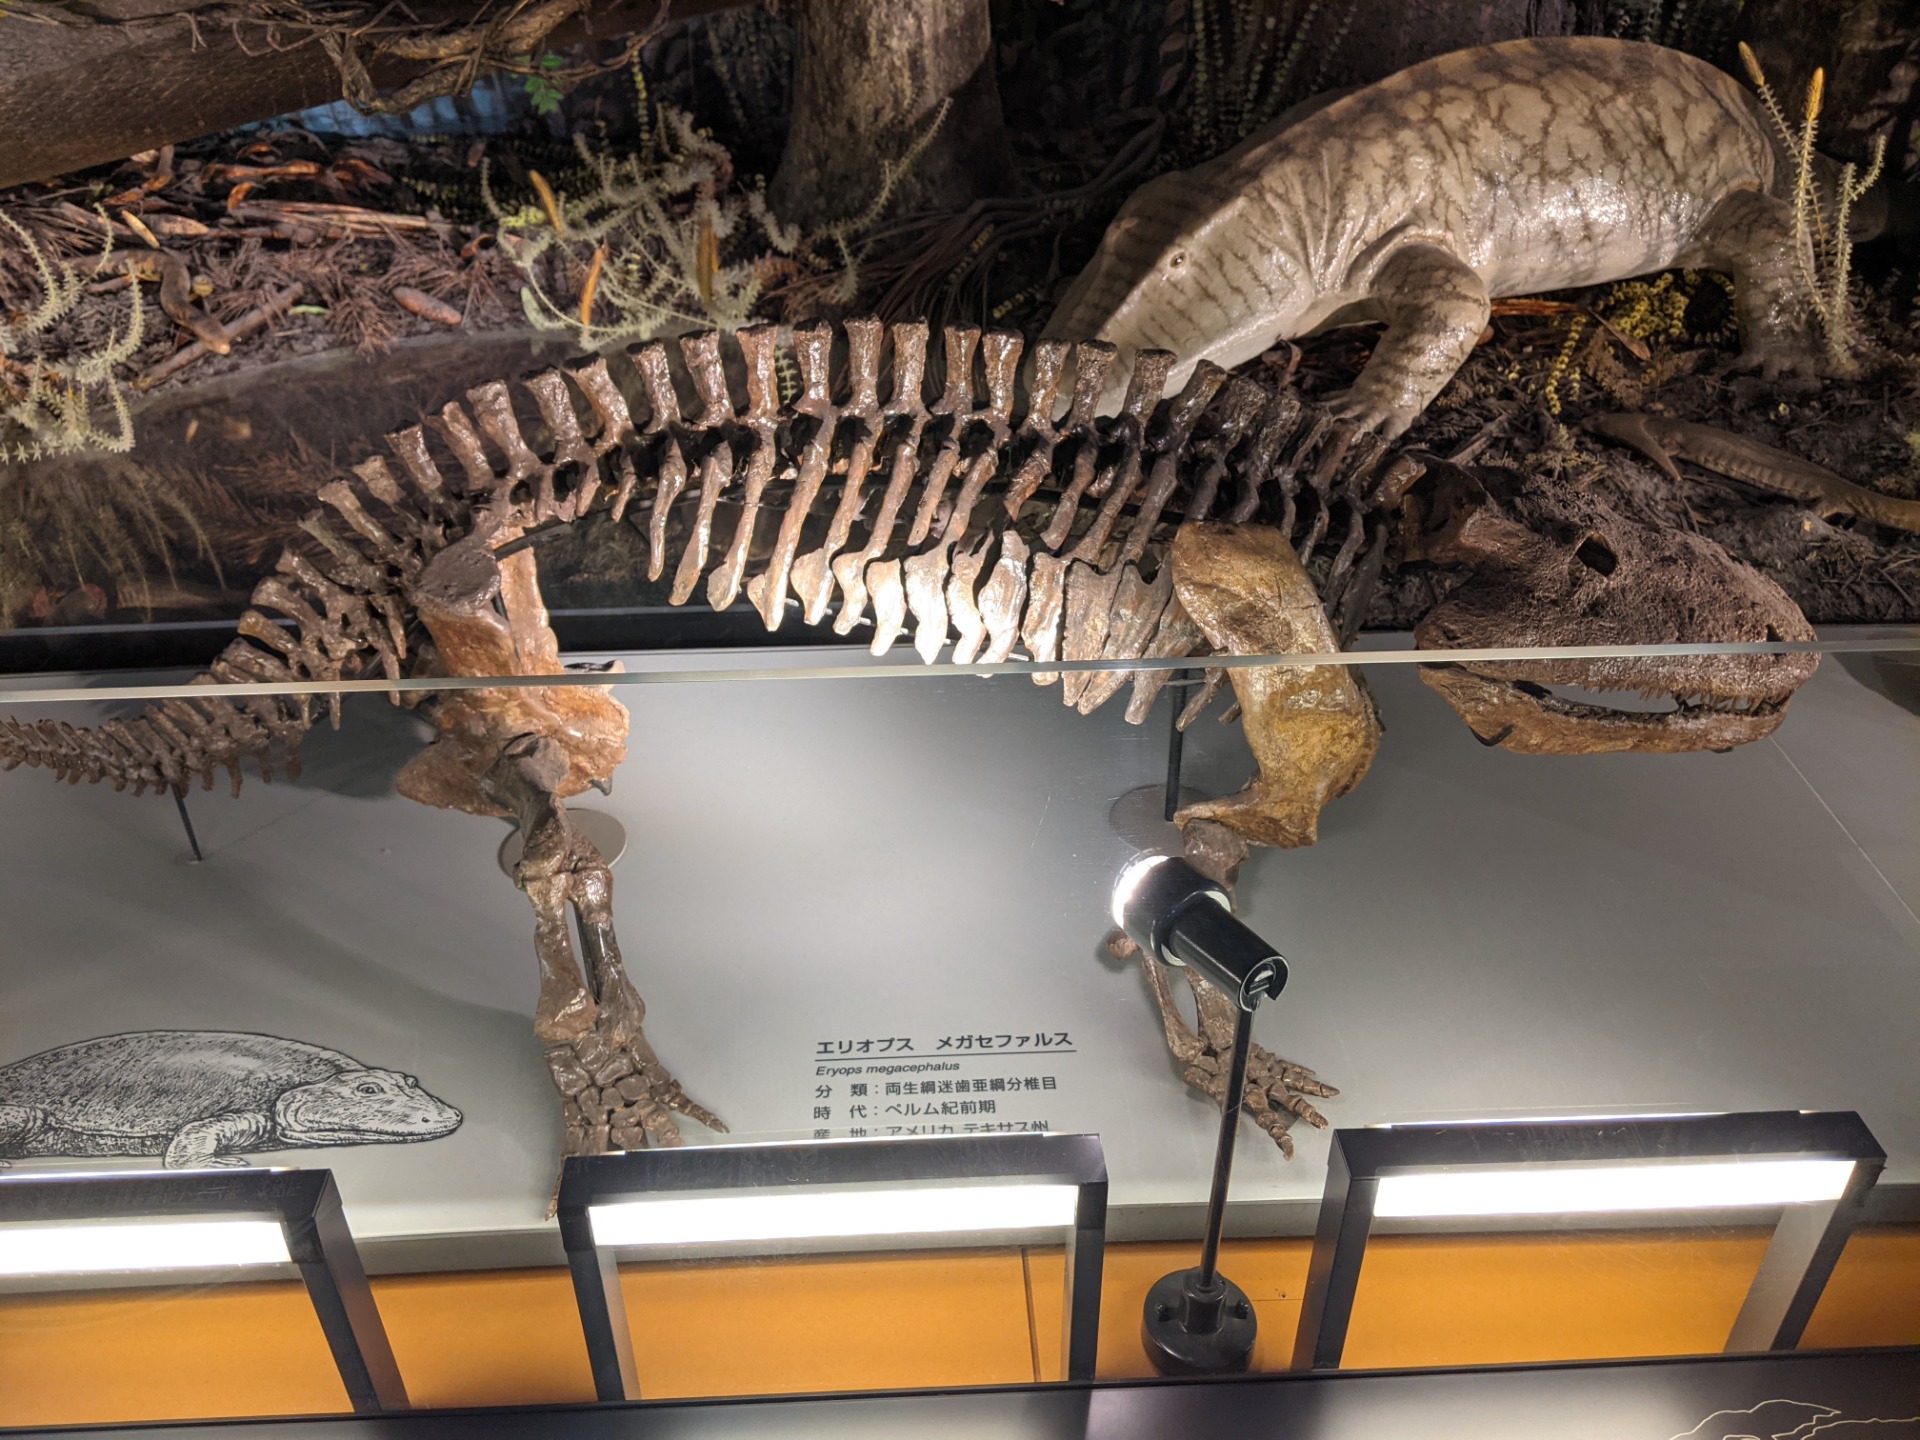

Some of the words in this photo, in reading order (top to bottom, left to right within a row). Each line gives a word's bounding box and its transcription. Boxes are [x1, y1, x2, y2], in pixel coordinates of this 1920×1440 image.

[816, 1037, 914, 1054] エリオプス
[936, 1032, 1073, 1050] メガセファルス
[816, 1066, 862, 1077] Eryops
[866, 1062, 960, 1075] megacephalus
